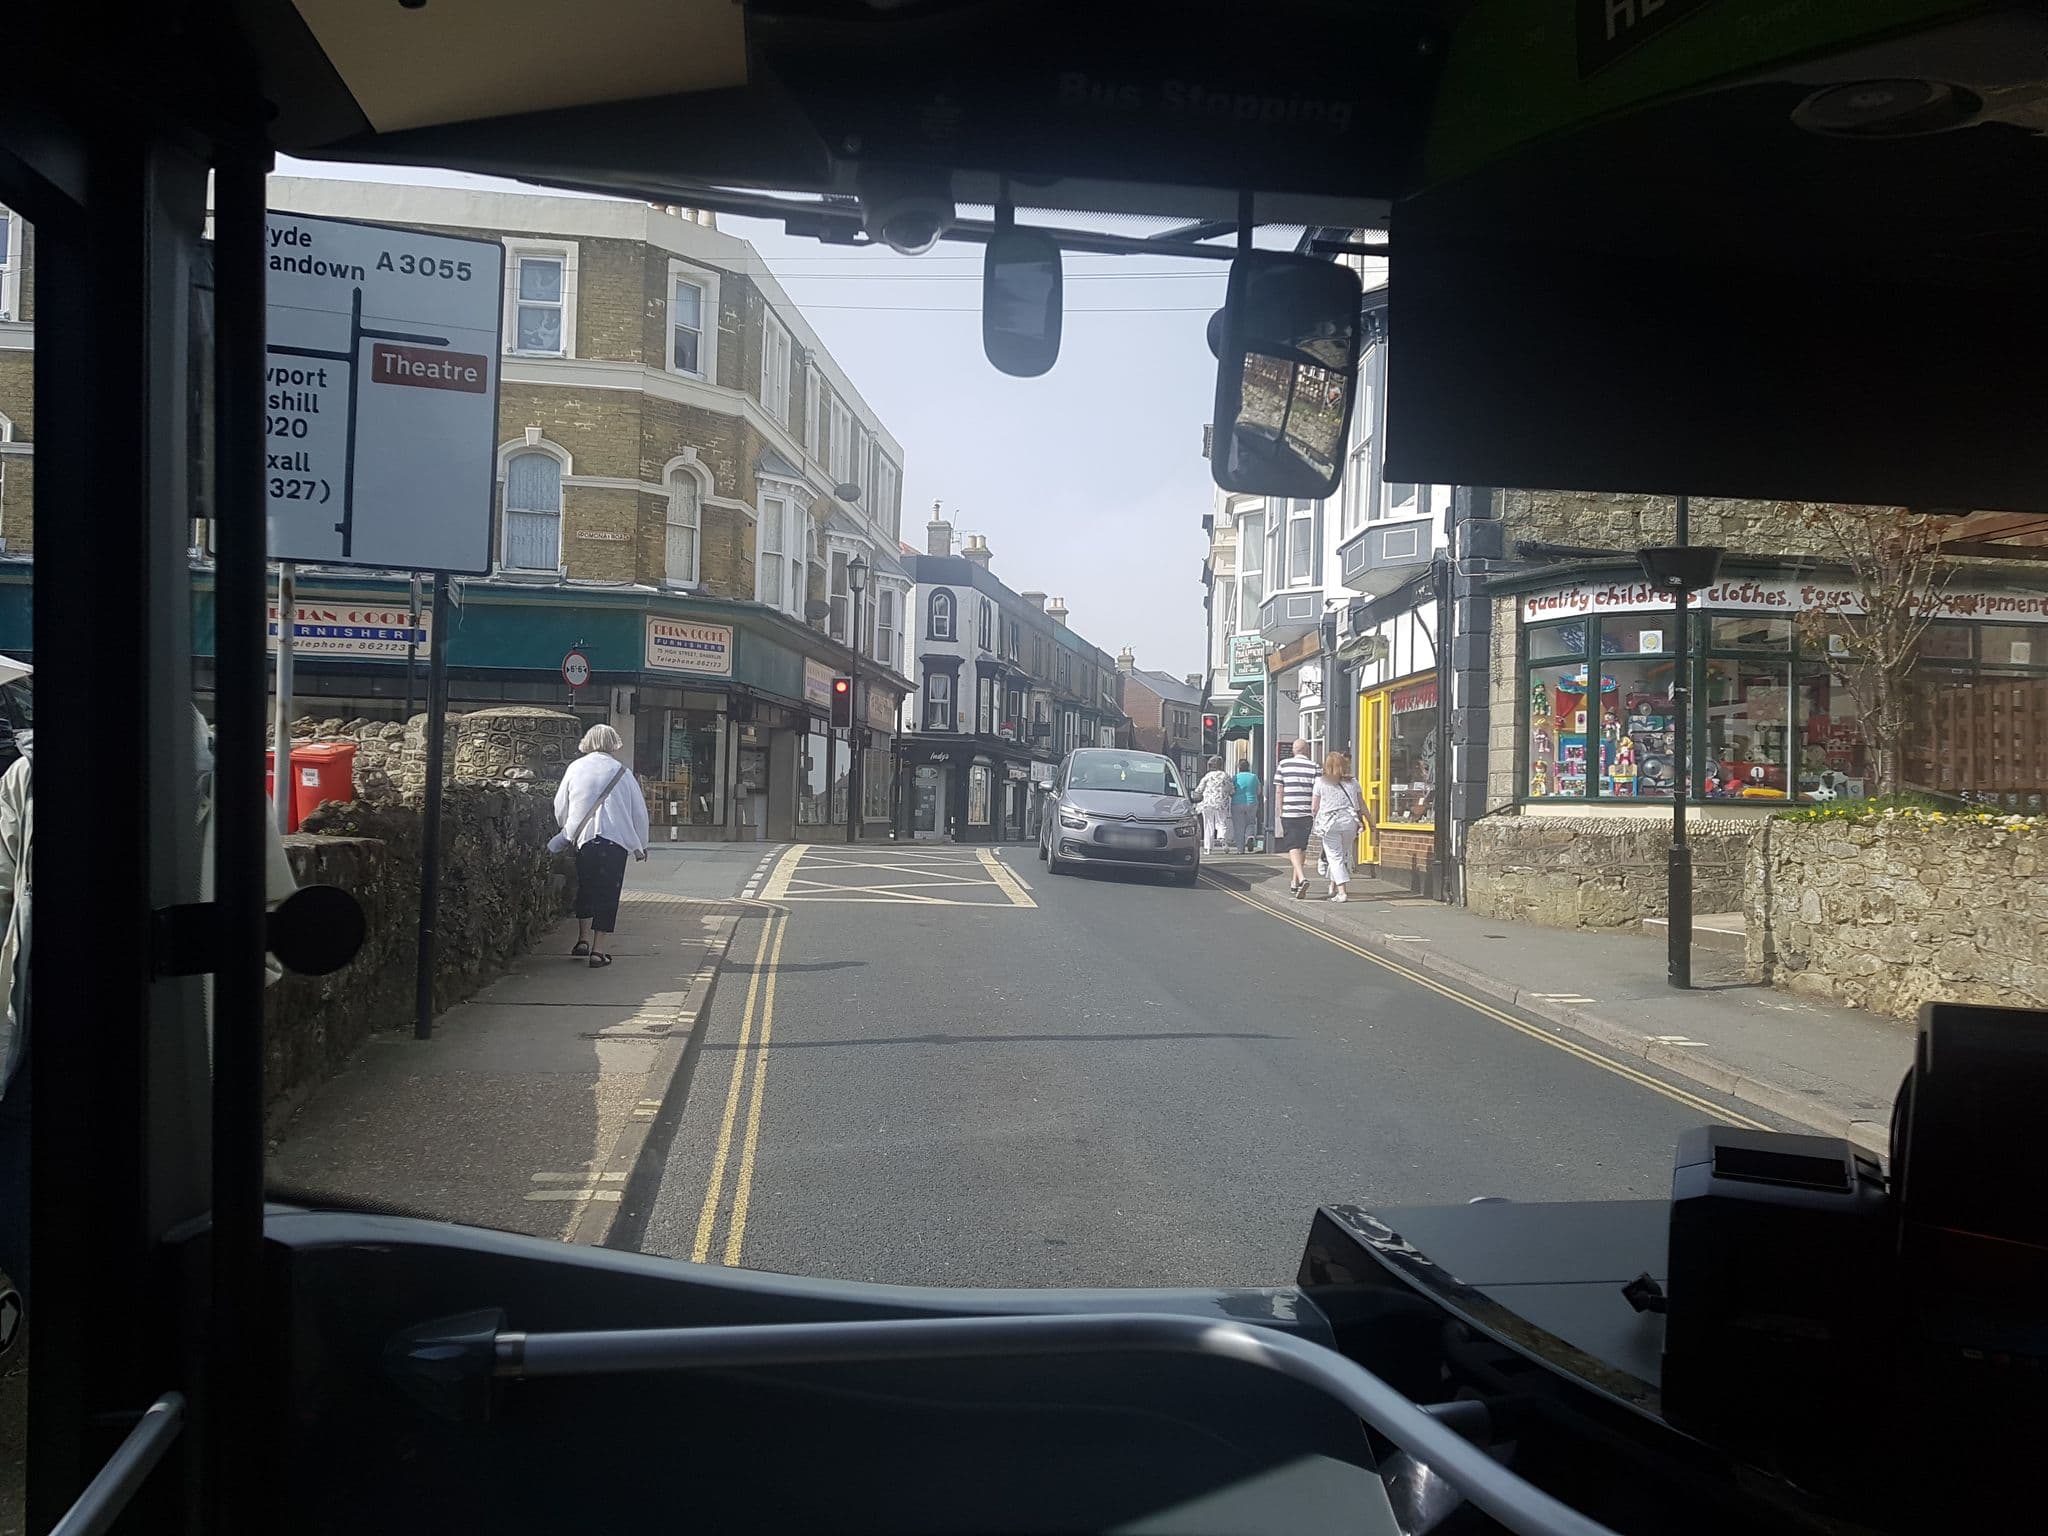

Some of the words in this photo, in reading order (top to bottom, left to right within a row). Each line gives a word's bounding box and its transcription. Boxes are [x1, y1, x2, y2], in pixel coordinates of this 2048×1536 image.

[267, 225, 312, 248] yde
[269, 255, 365, 281] andown
[381, 353, 478, 382] Theatre
[268, 391, 319, 413] shill
[266, 452, 310, 471] xall
[269, 478, 331, 503] 327)
[1528, 588, 1589, 615] quality
[1801, 585, 1852, 606] toys
[654, 625, 688, 637] BRIAN
[691, 628, 725, 642] COOKE
[656, 638, 722, 651] FURNISHERS
[358, 643, 406, 651] 862123
[656, 656, 696, 665] Telephone
